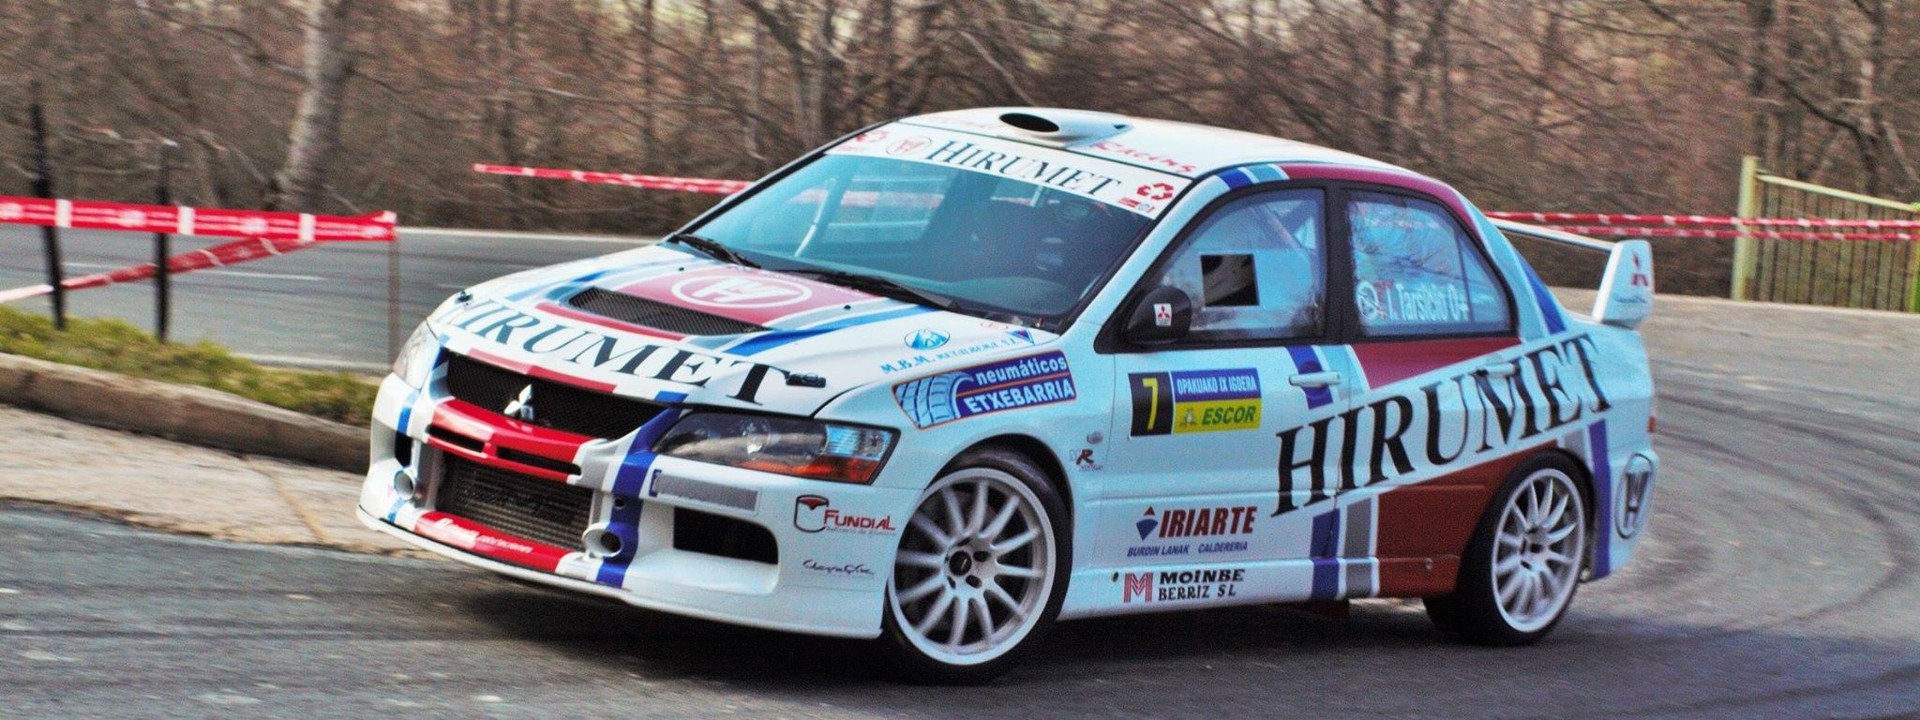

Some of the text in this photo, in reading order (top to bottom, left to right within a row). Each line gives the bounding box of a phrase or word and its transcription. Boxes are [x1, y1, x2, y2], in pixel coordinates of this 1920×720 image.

[926, 140, 1122, 196] HIRUMET
[434, 298, 792, 406] HIRUMET
[975, 356, 1068, 386] neumáticos
[1177, 376, 1218, 395] OPAKUAKO
[963, 379, 1075, 414] ETXEBARRIA
[1142, 377, 1159, 430] 7
[1202, 405, 1257, 426] ESCOR
[1271, 333, 1611, 519] HIRUMET
[1158, 506, 1258, 538] IRIARTE
[1127, 541, 1248, 557] BURDIN LANAK CALDERERIA
[1159, 569, 1246, 584] MOINBE
[1158, 585, 1210, 601] BERRIZ
